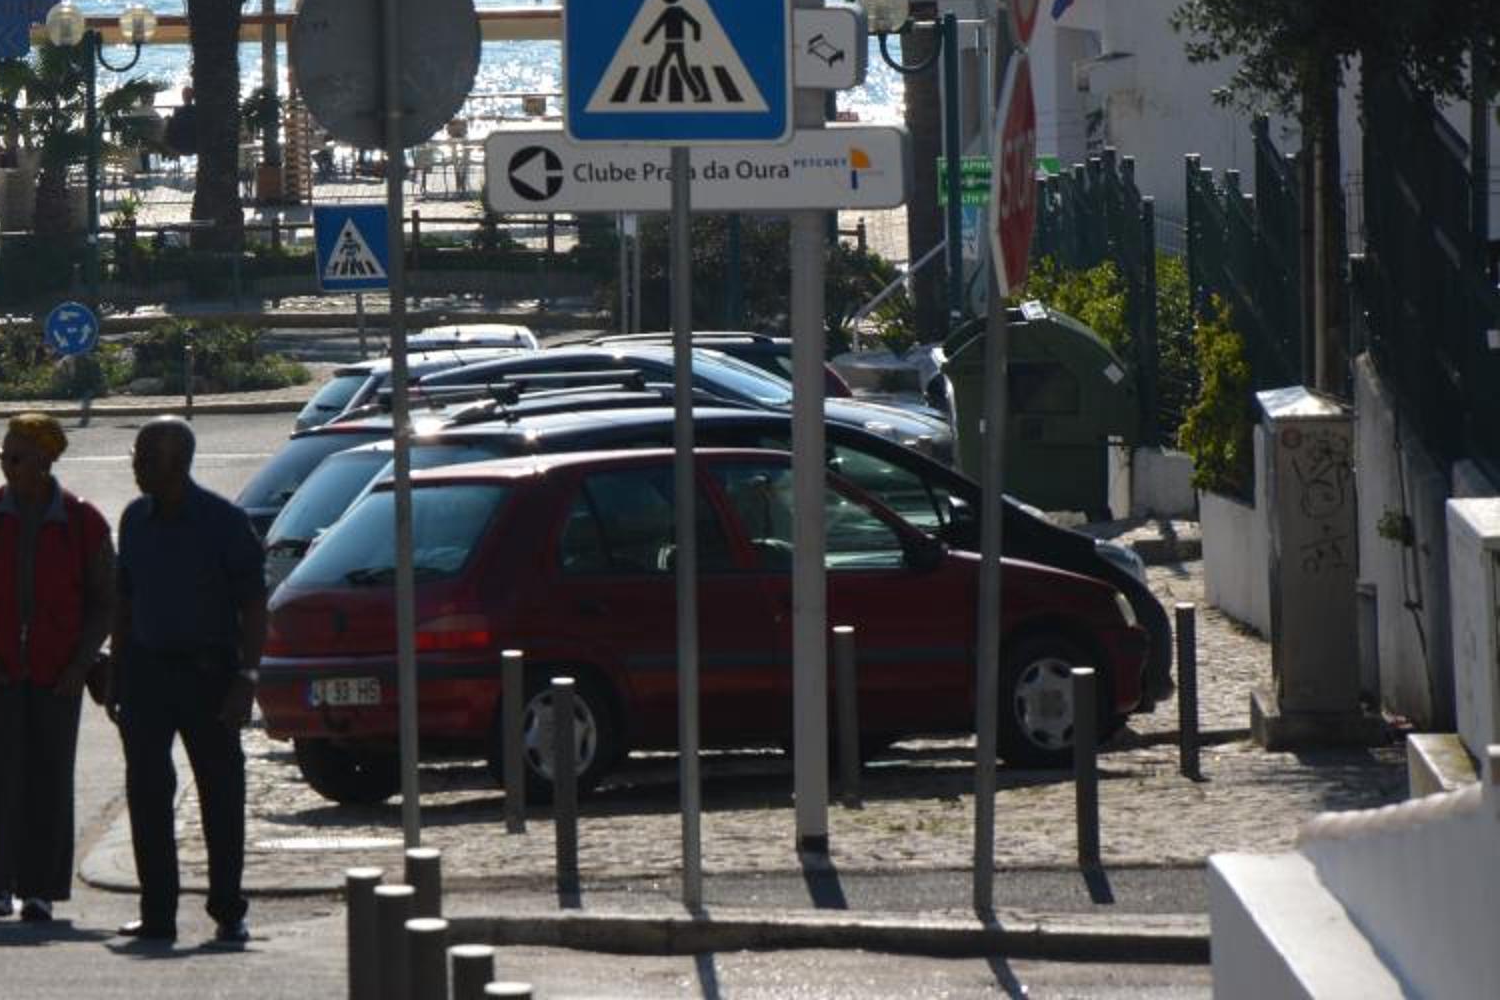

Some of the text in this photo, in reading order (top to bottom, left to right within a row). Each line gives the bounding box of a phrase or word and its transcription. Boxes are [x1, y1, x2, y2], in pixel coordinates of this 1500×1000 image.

[573, 162, 636, 183] Clube
[703, 160, 730, 180] da
[735, 159, 790, 180] Oura
